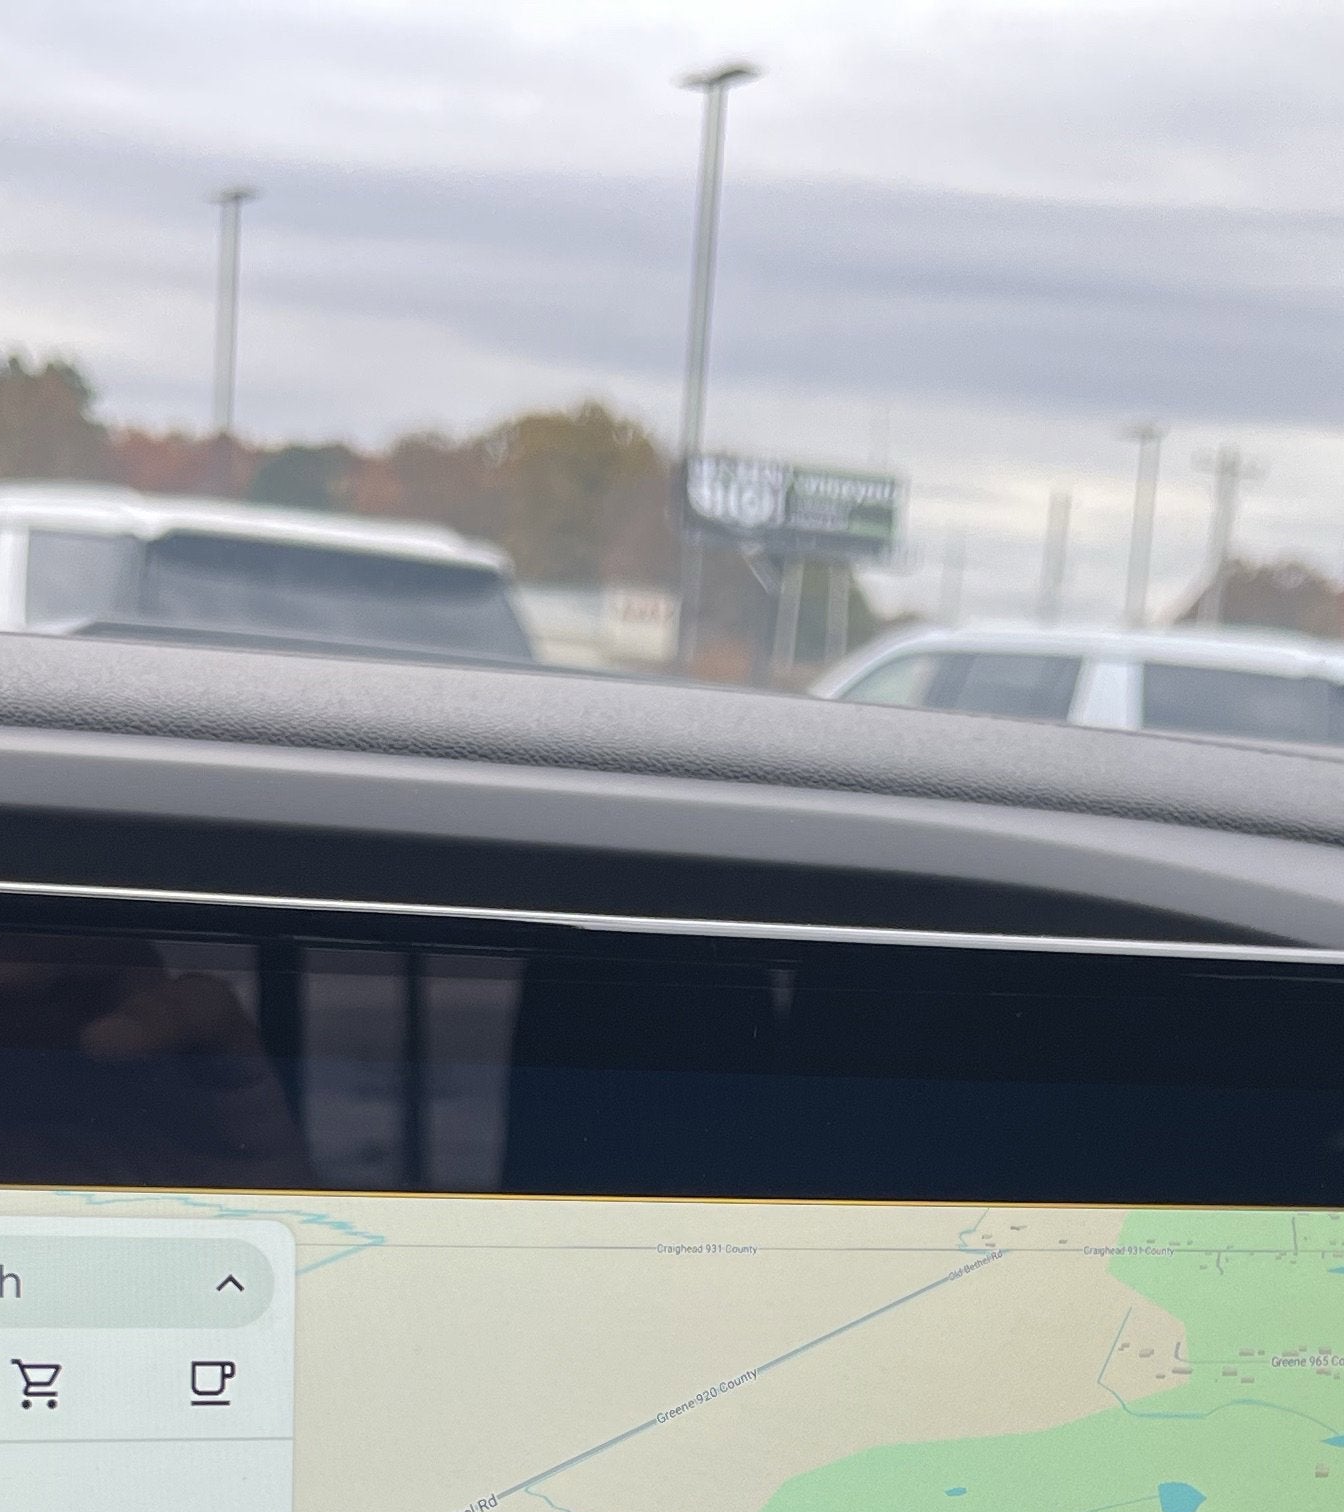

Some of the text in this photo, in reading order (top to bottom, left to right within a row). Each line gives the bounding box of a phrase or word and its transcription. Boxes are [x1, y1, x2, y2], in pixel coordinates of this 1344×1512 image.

[656, 1243, 758, 1255] Craighead 931 County
[1083, 1246, 1125, 1257] Craighead
[1144, 1246, 1175, 1257] County
[1271, 1356, 1307, 1368] Greene
[1308, 1355, 1329, 1367] 965
[656, 1368, 758, 1424] Greene 920 County
[477, 1493, 498, 1512] Rd
